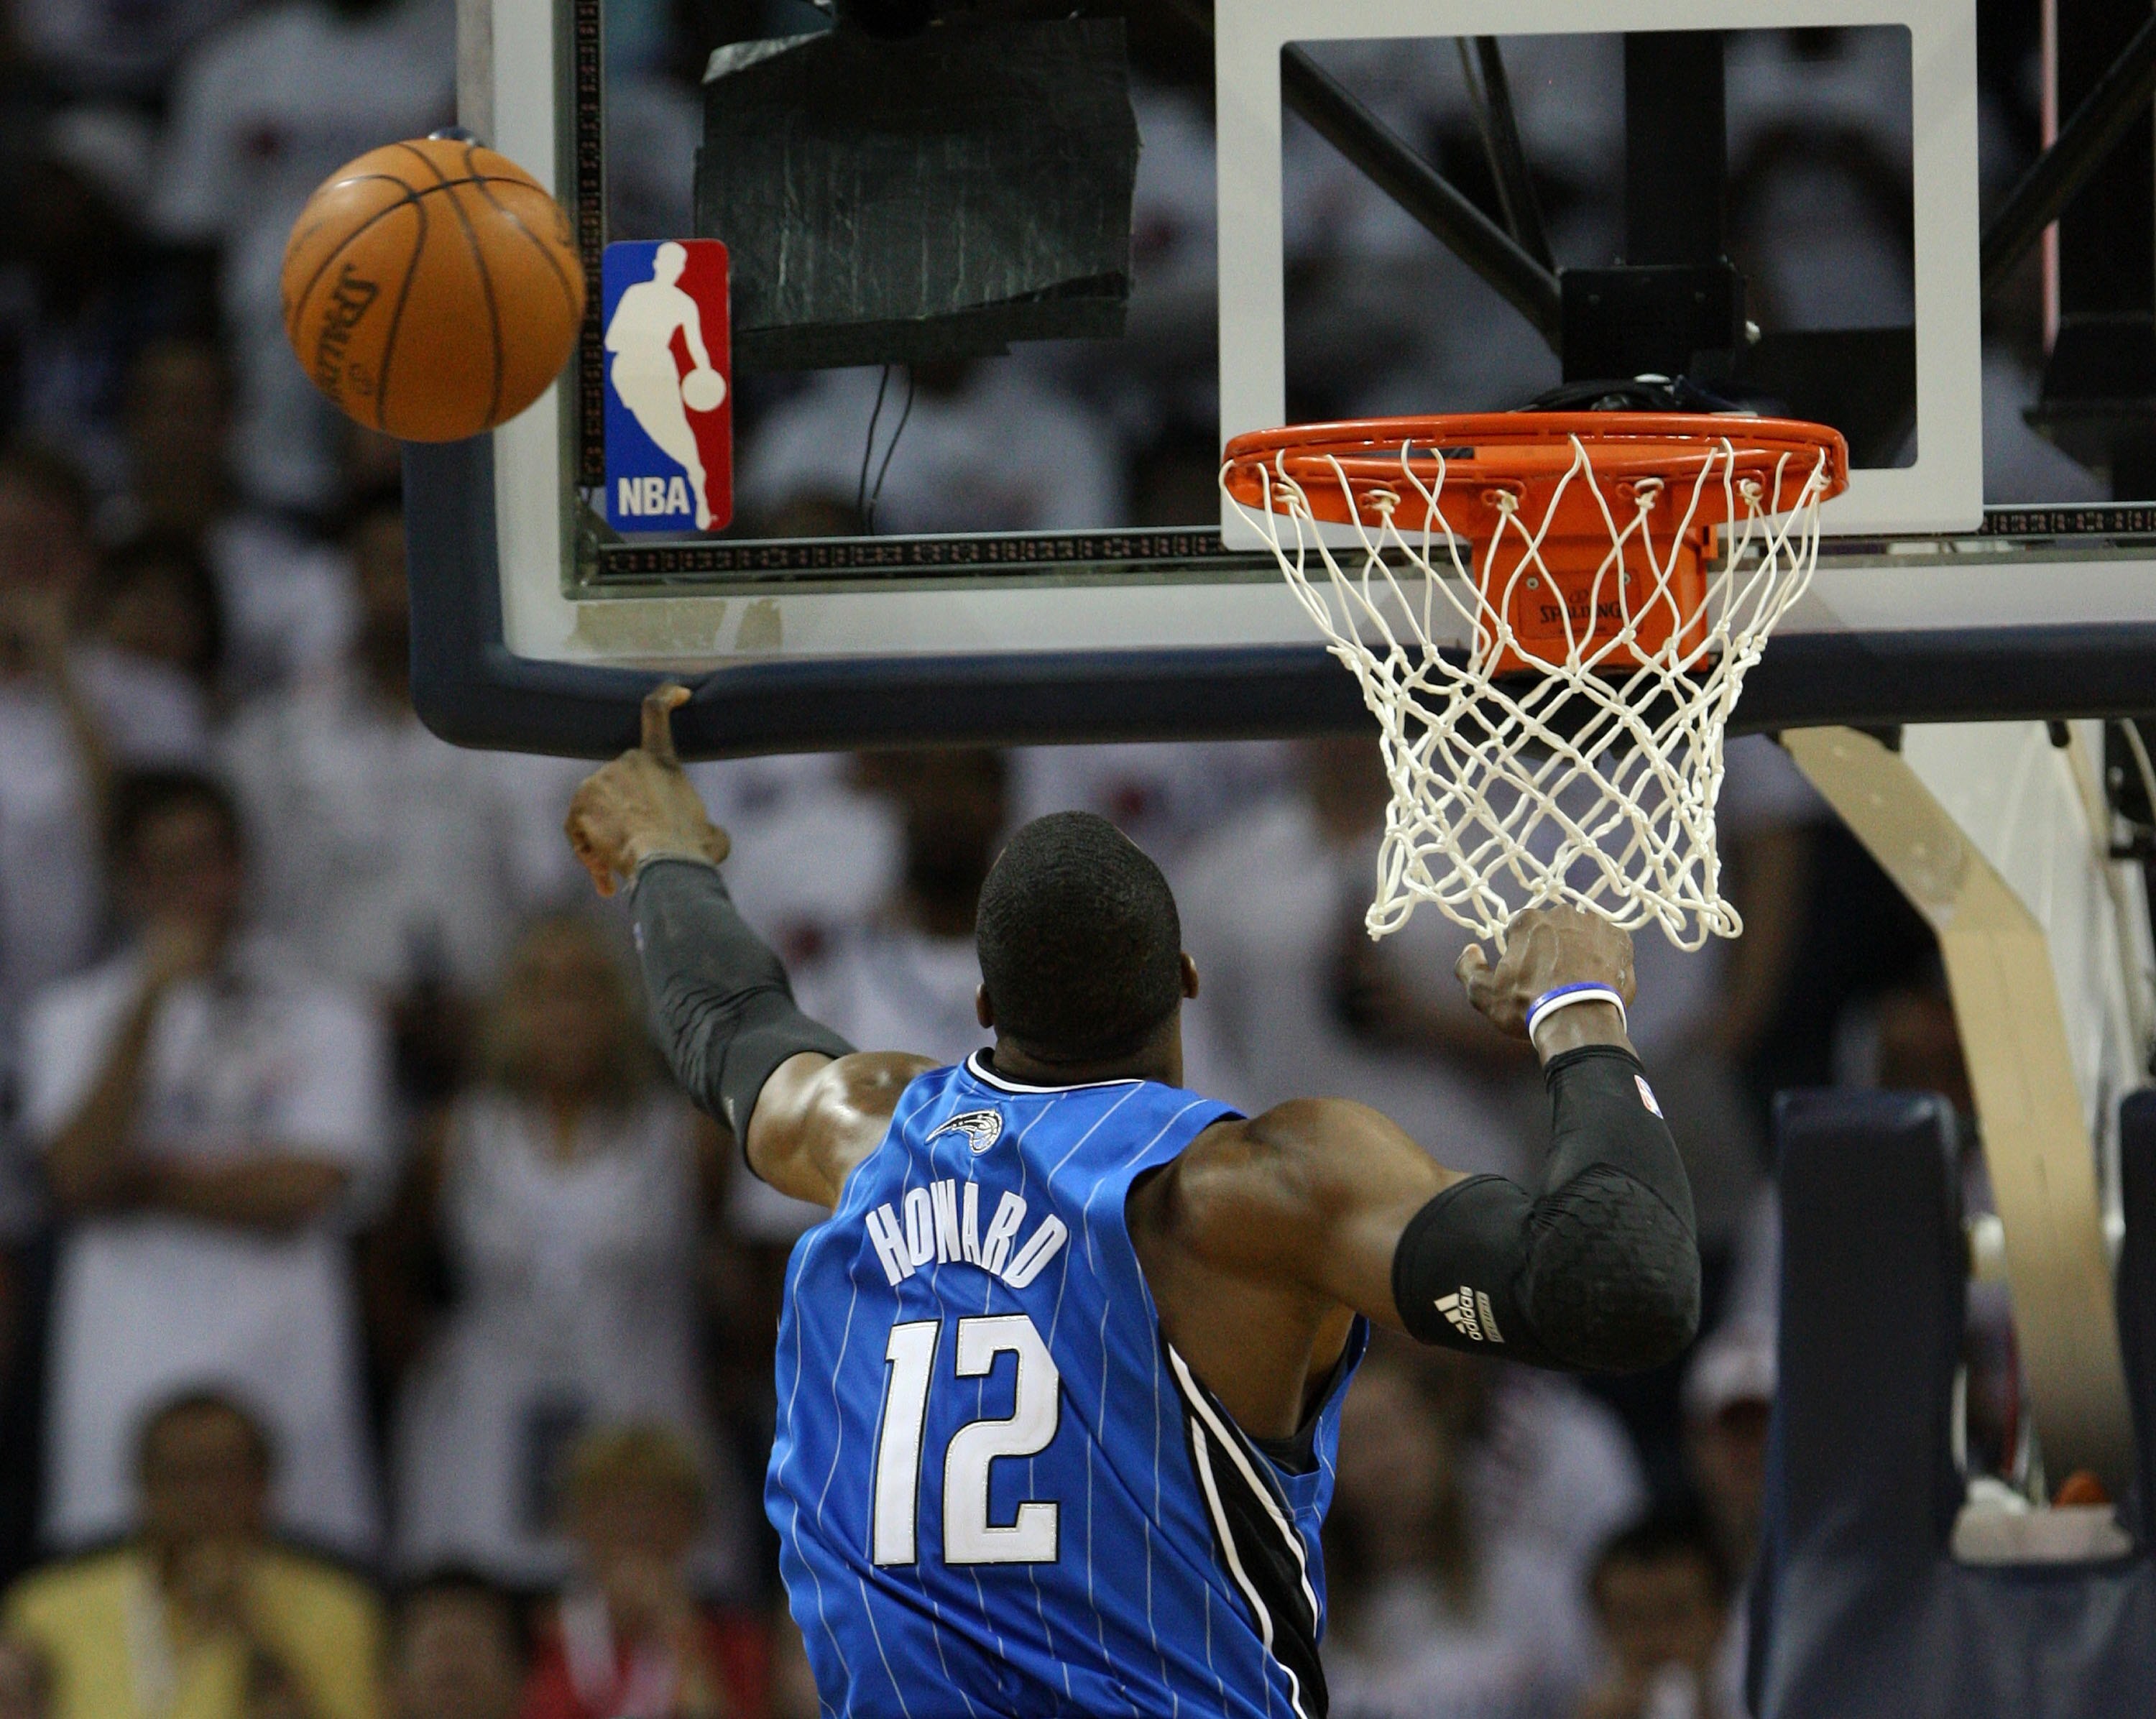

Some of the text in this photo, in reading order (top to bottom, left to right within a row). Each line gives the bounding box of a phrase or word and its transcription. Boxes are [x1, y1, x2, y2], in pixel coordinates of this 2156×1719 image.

[315, 262, 379, 402] SPALD
[619, 477, 691, 516] NBA
[1540, 601, 1621, 624] SPLDNG
[865, 1178, 1069, 1289] HOWARD
[1460, 1285, 1483, 1341] adidas
[872, 1314, 1061, 1565] 12
